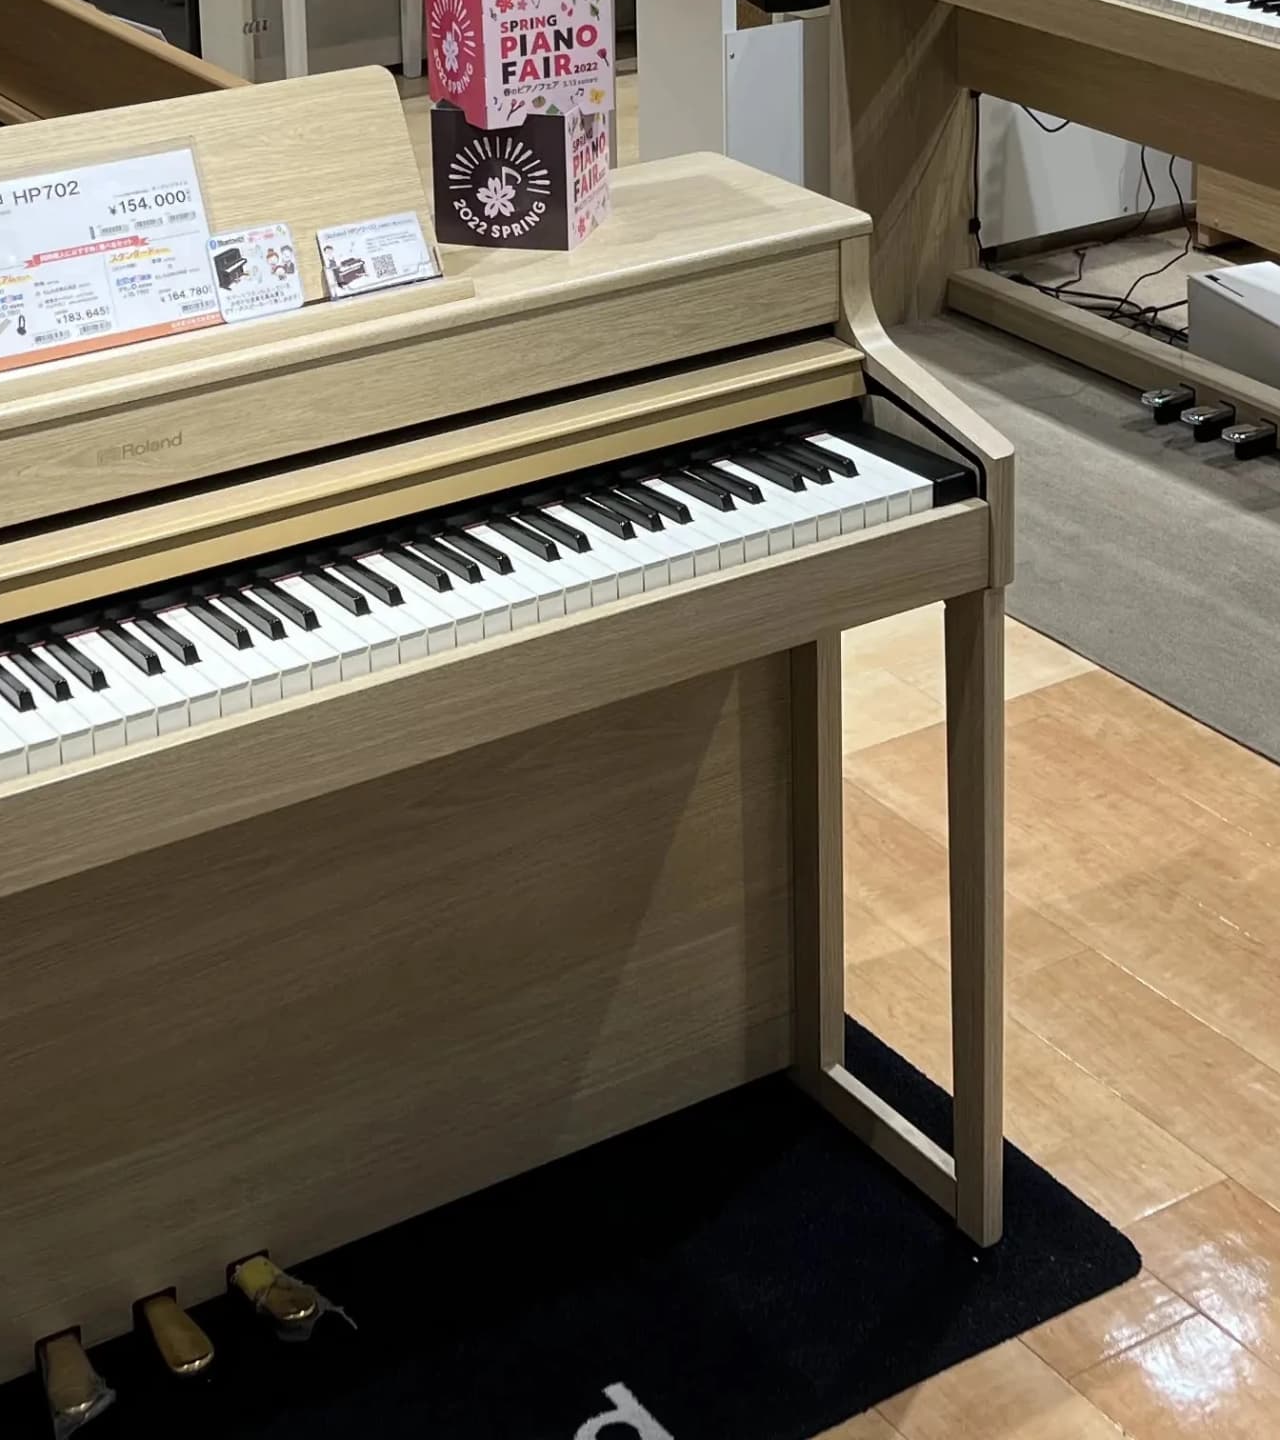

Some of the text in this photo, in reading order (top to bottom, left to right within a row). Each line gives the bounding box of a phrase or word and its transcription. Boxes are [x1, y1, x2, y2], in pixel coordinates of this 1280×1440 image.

[500, 14, 557, 34] SPRING
[500, 24, 598, 60] PIANO
[447, 61, 474, 95] SPRING
[501, 53, 598, 85] FAIR 2022
[572, 127, 594, 152] SPRING
[572, 131, 606, 174] PIANO
[13, 180, 80, 206] HP702
[573, 168, 599, 204] FAIR
[453, 199, 488, 236] 2022
[491, 200, 547, 239] SPRING
[121, 432, 183, 459] Roland
